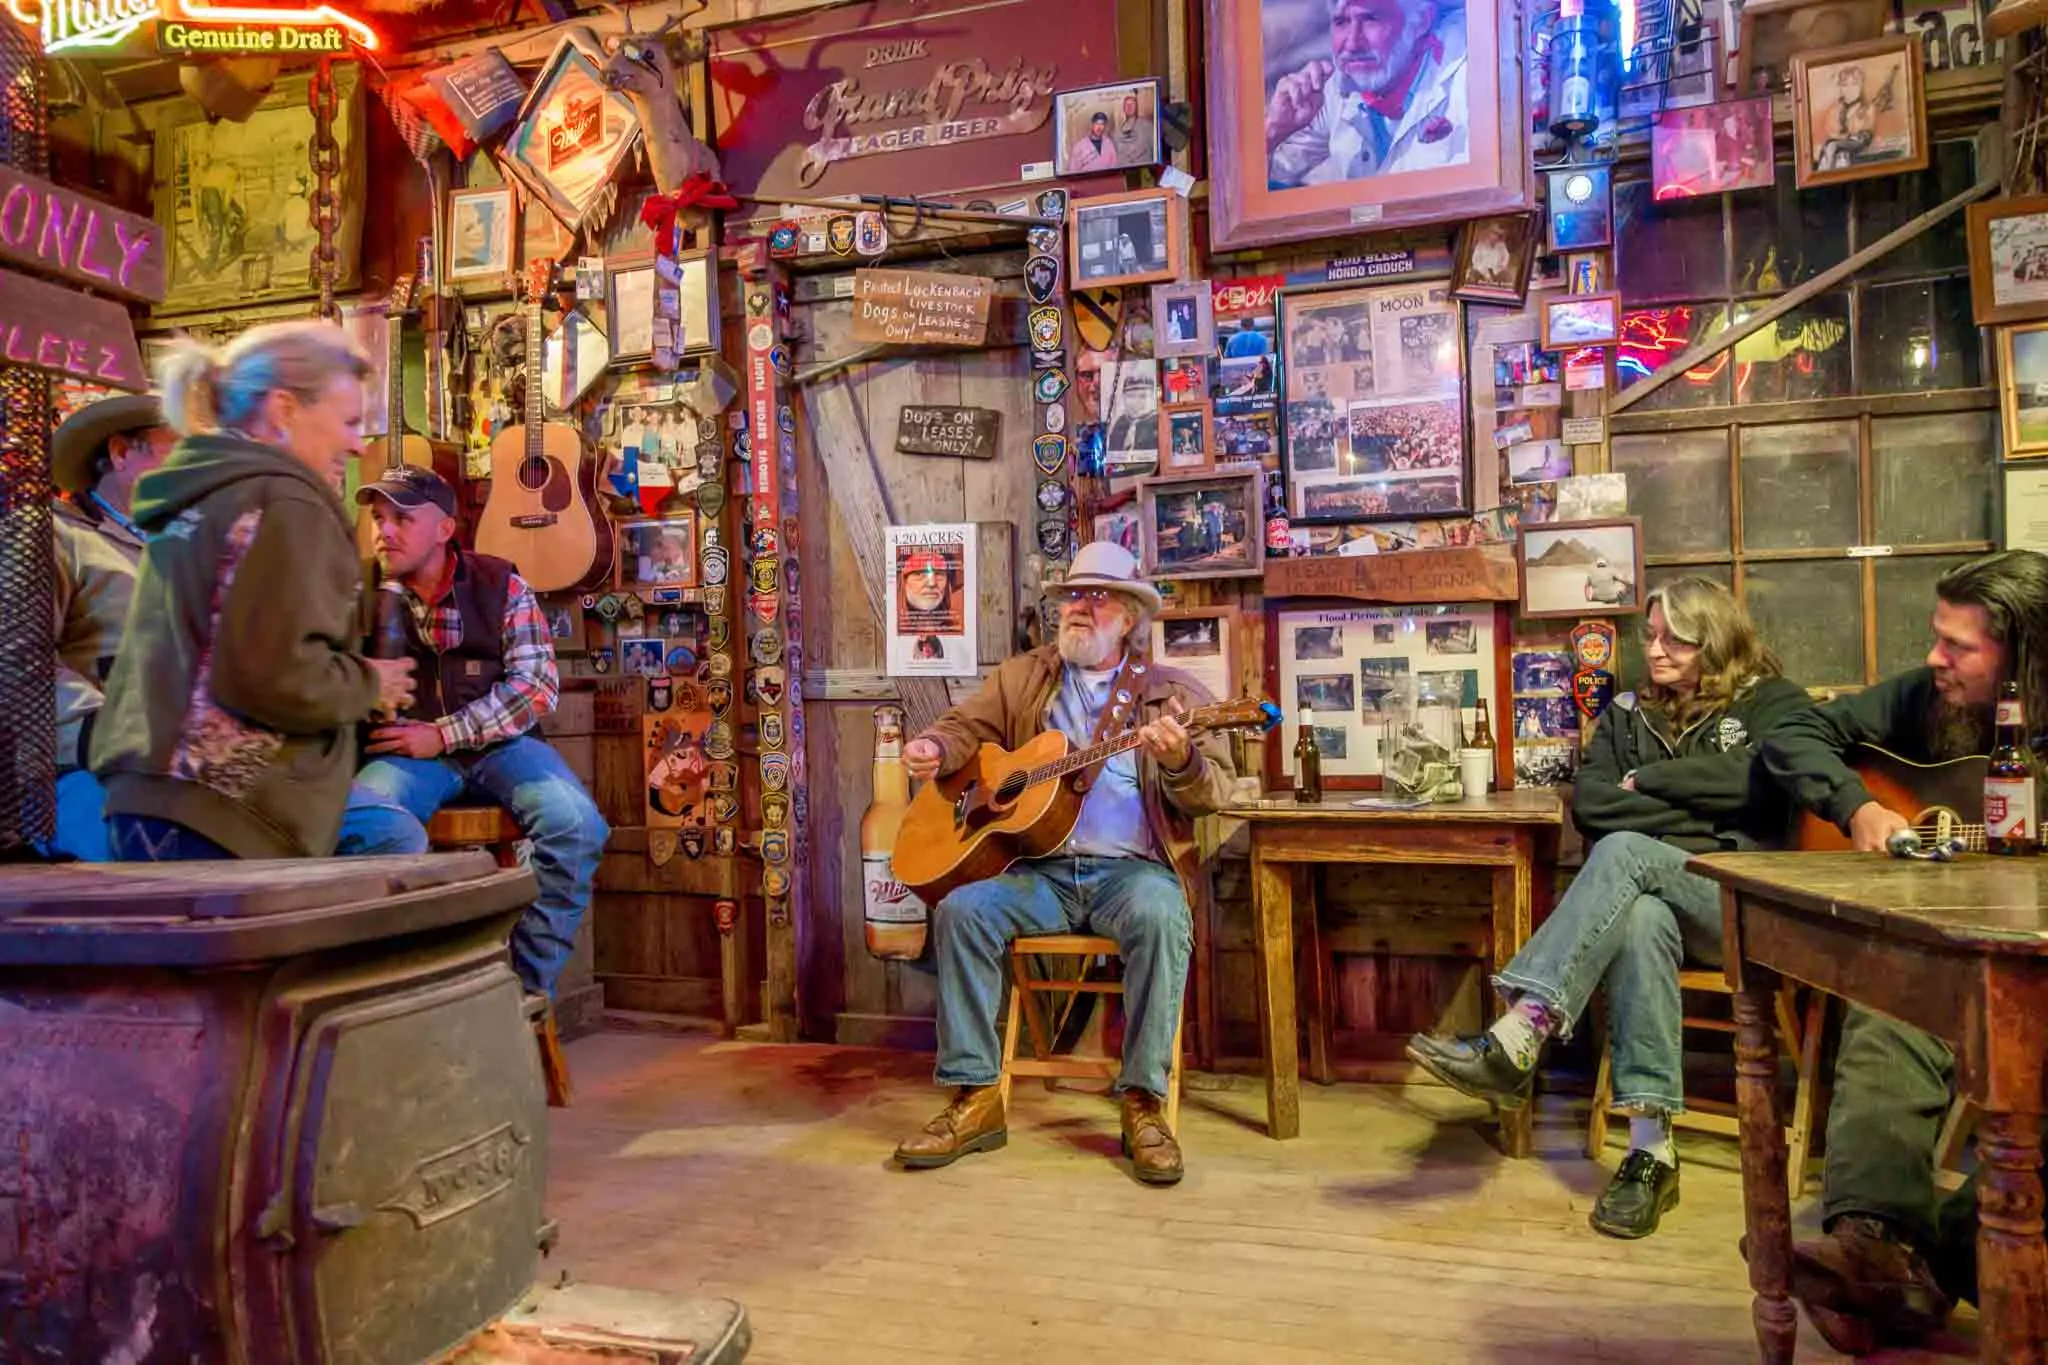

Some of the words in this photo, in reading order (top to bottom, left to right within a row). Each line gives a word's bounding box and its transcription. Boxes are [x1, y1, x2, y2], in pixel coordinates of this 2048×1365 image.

[10, 0, 160, 53] Mille
[165, 25, 273, 49] Genuine
[280, 26, 341, 50] Draft
[864, 40, 930, 68] DRINK
[803, 66, 956, 147] Grand
[552, 112, 596, 147] Miller
[852, 127, 926, 152] LAGER
[939, 118, 1000, 140] BEER
[0, 183, 153, 288] ONLY
[1328, 265, 1366, 280] HONDO
[1368, 260, 1413, 275] CROUCH
[904, 275, 981, 298] LUCKENBACH
[863, 301, 899, 325] Dogs
[909, 298, 976, 315] LIVESTOCK
[1380, 296, 1424, 313] MOON
[0, 320, 127, 382] LEEZ
[755, 357, 767, 392] FLIGHT
[756, 399, 769, 440] BEFORE
[953, 411, 974, 425] ON
[921, 426, 974, 441] LEASES
[758, 449, 770, 494] REMOVE
[920, 530, 964, 544] ACRES
[1319, 614, 1345, 622] Flood
[1578, 676, 1608, 686] POLICE
